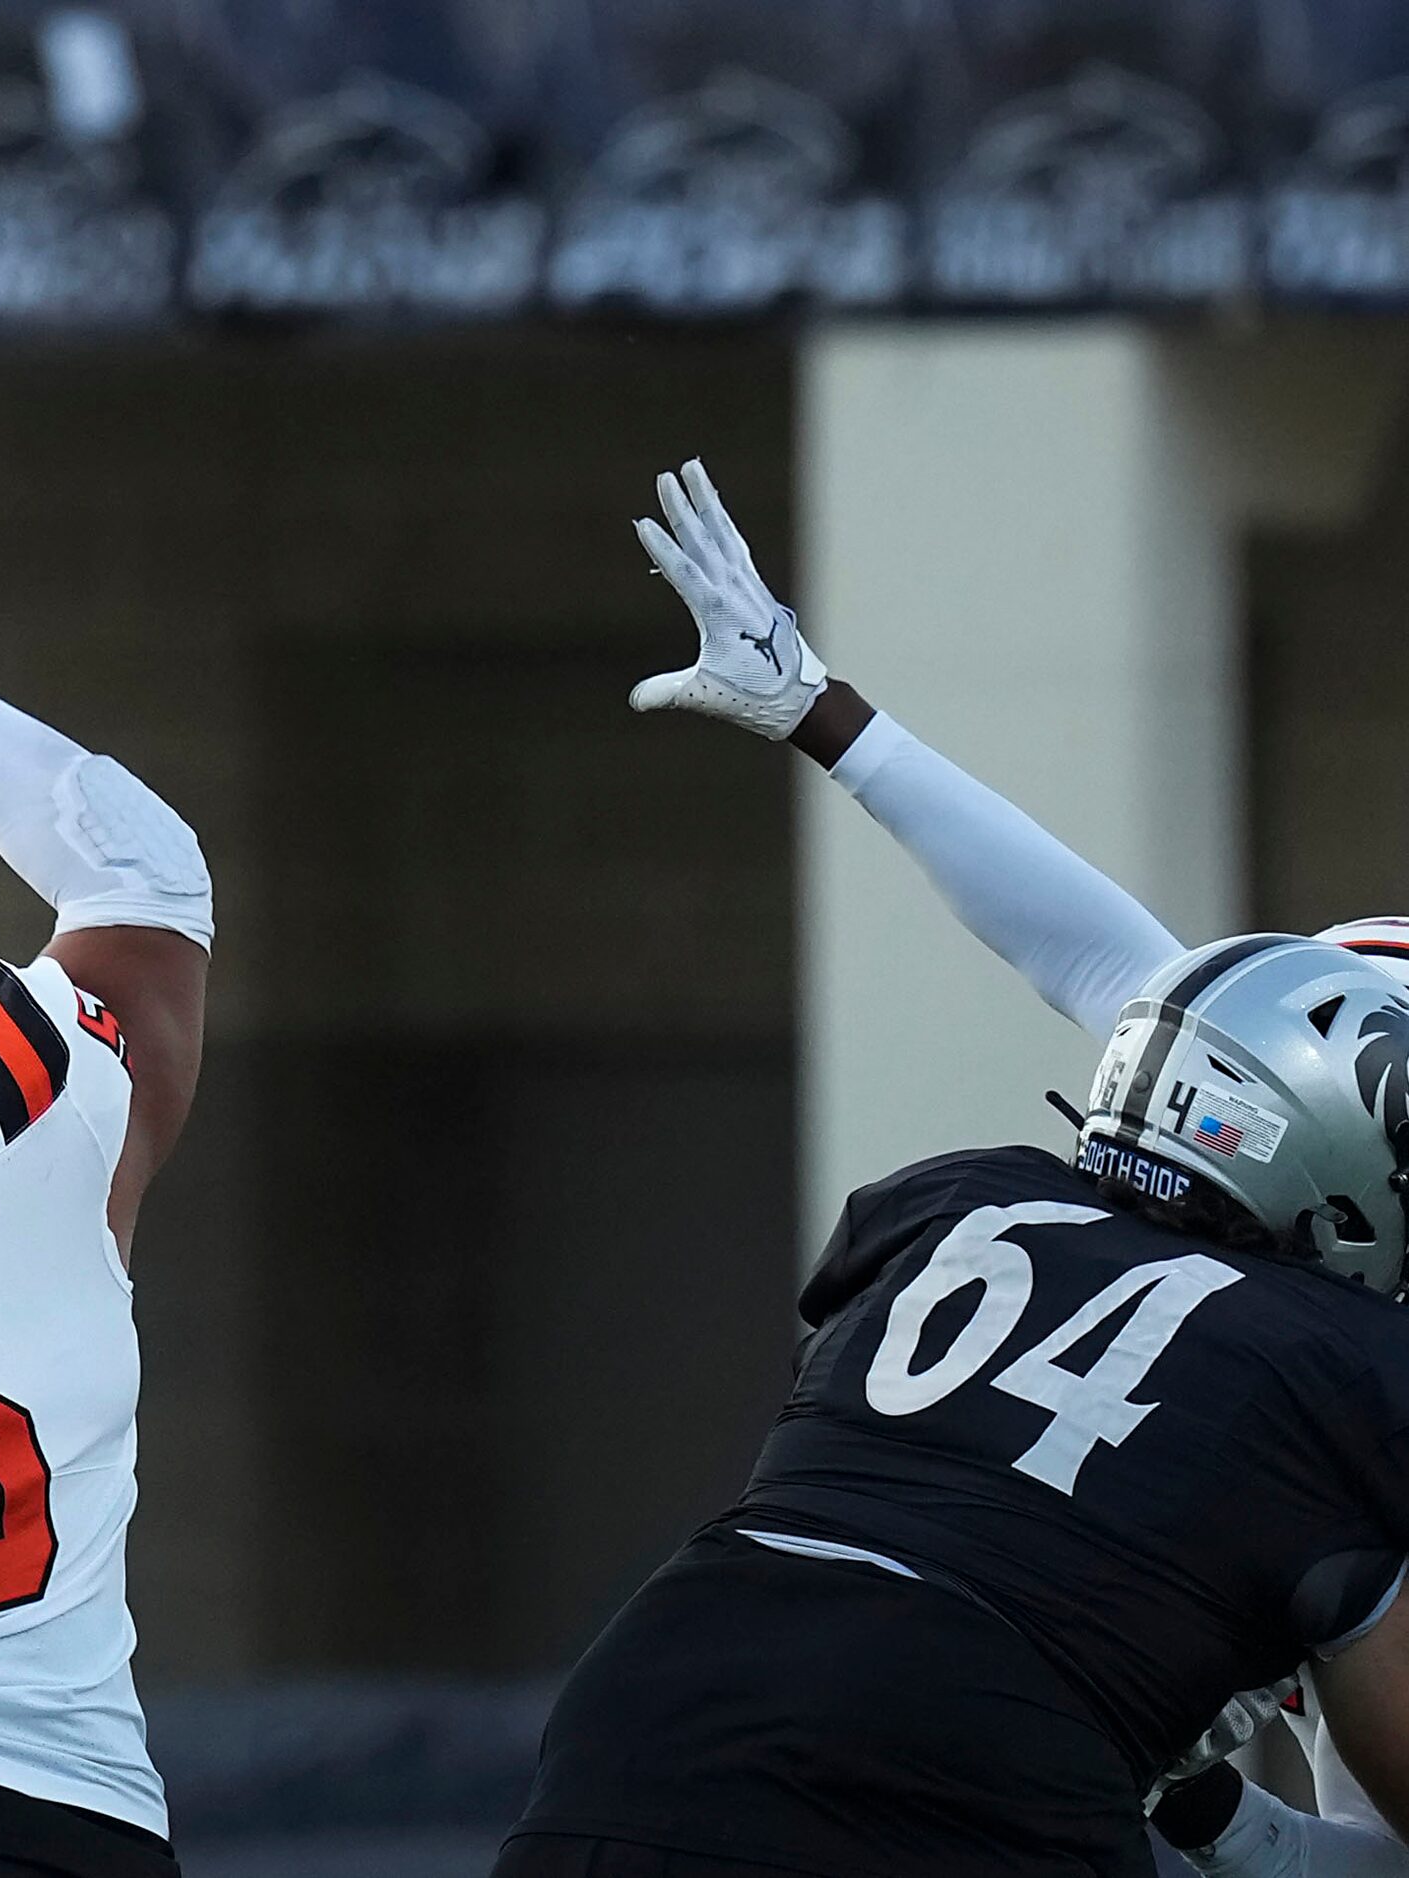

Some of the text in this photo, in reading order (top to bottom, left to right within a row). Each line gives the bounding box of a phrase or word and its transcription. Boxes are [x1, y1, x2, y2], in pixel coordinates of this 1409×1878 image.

[1167, 1080, 1198, 1134] 4
[1078, 1138, 1190, 1201] SOUTHSIDE
[866, 1201, 1246, 1497] 64
